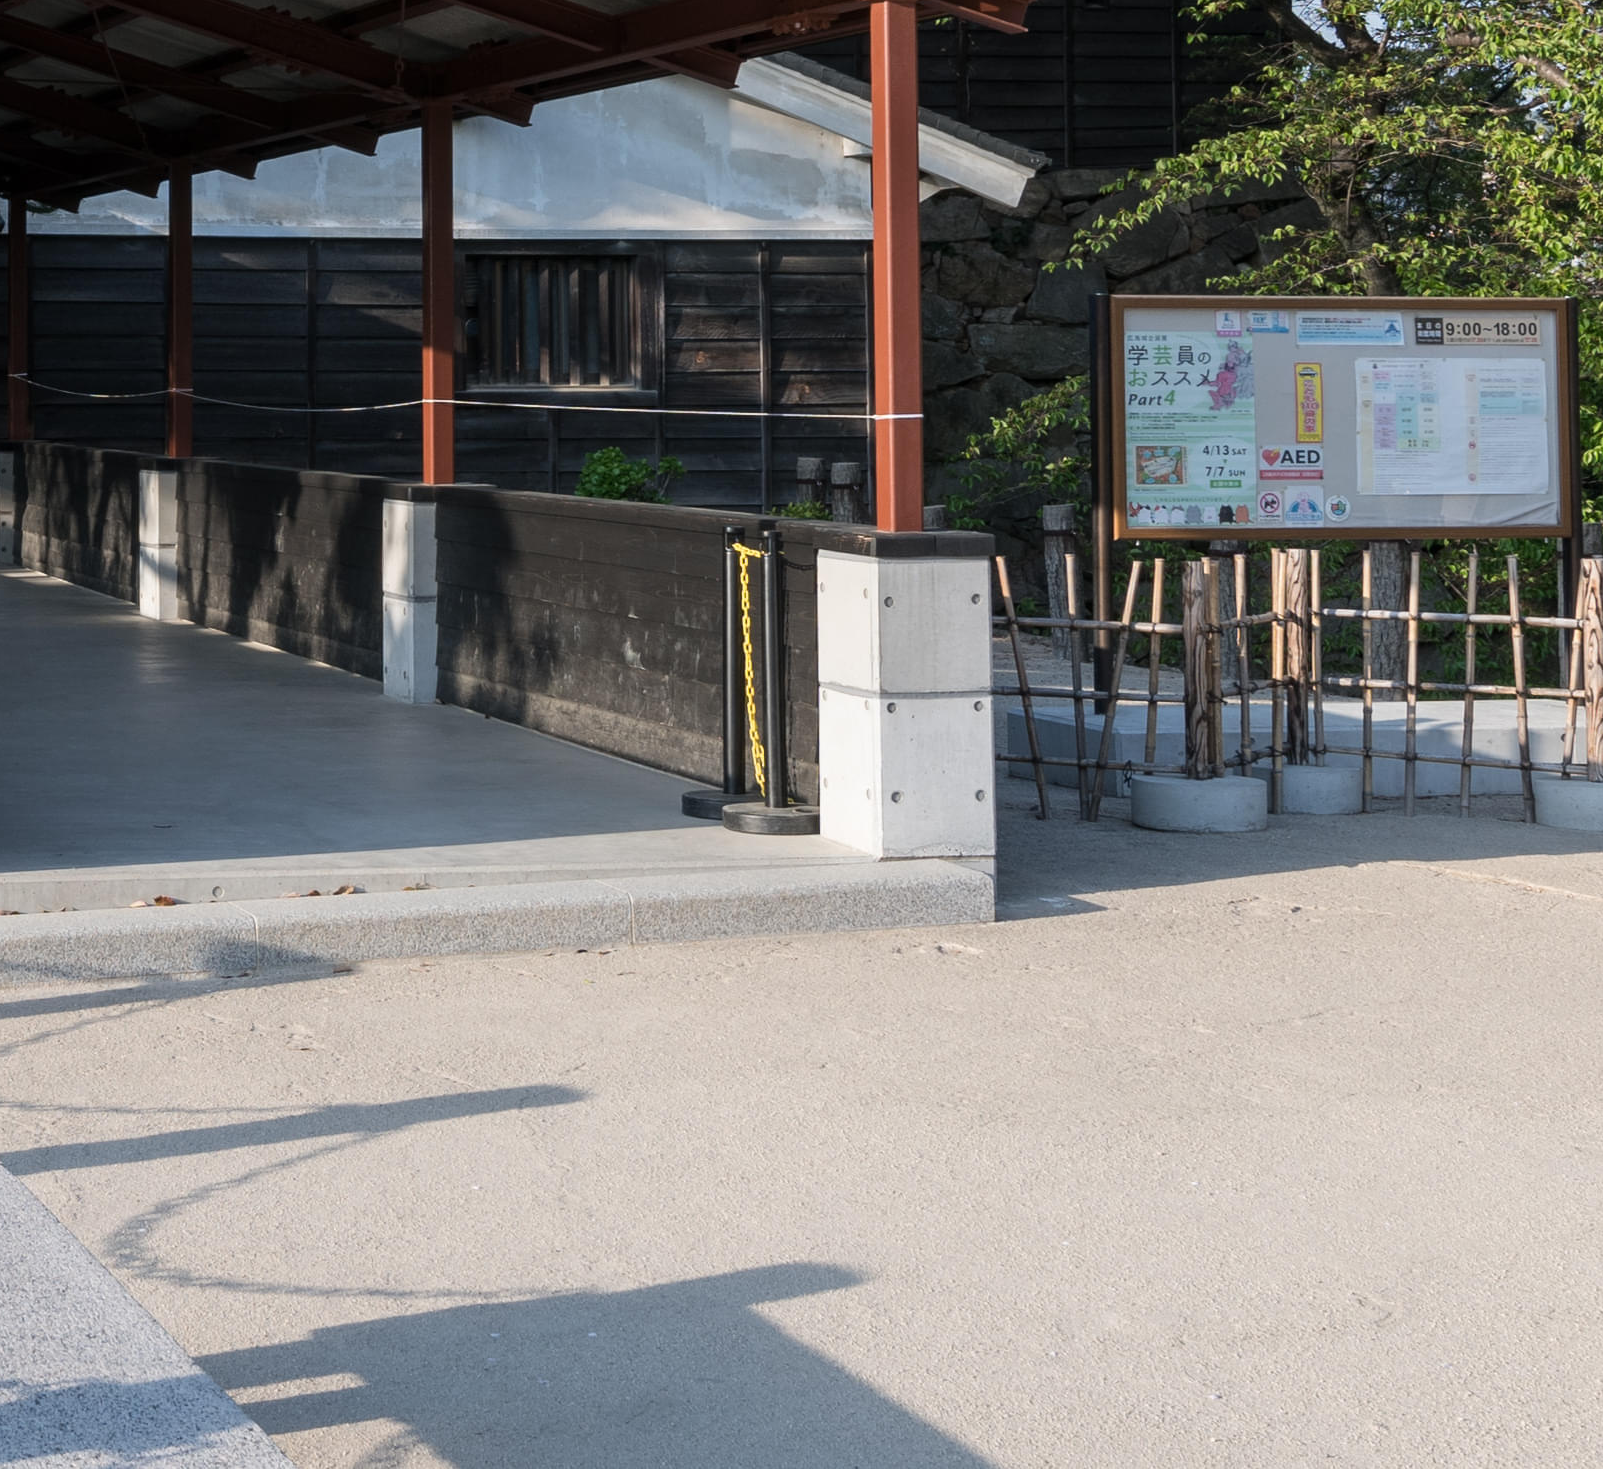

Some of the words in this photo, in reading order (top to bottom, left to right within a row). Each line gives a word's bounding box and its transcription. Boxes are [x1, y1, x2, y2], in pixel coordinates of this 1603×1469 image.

[1127, 345, 1211, 366] 学芸員の
[1128, 368, 1211, 387] おススメ
[1203, 445, 1230, 456] 4/13
[1280, 450, 1320, 464] AED
[1205, 466, 1225, 477] 7/7
